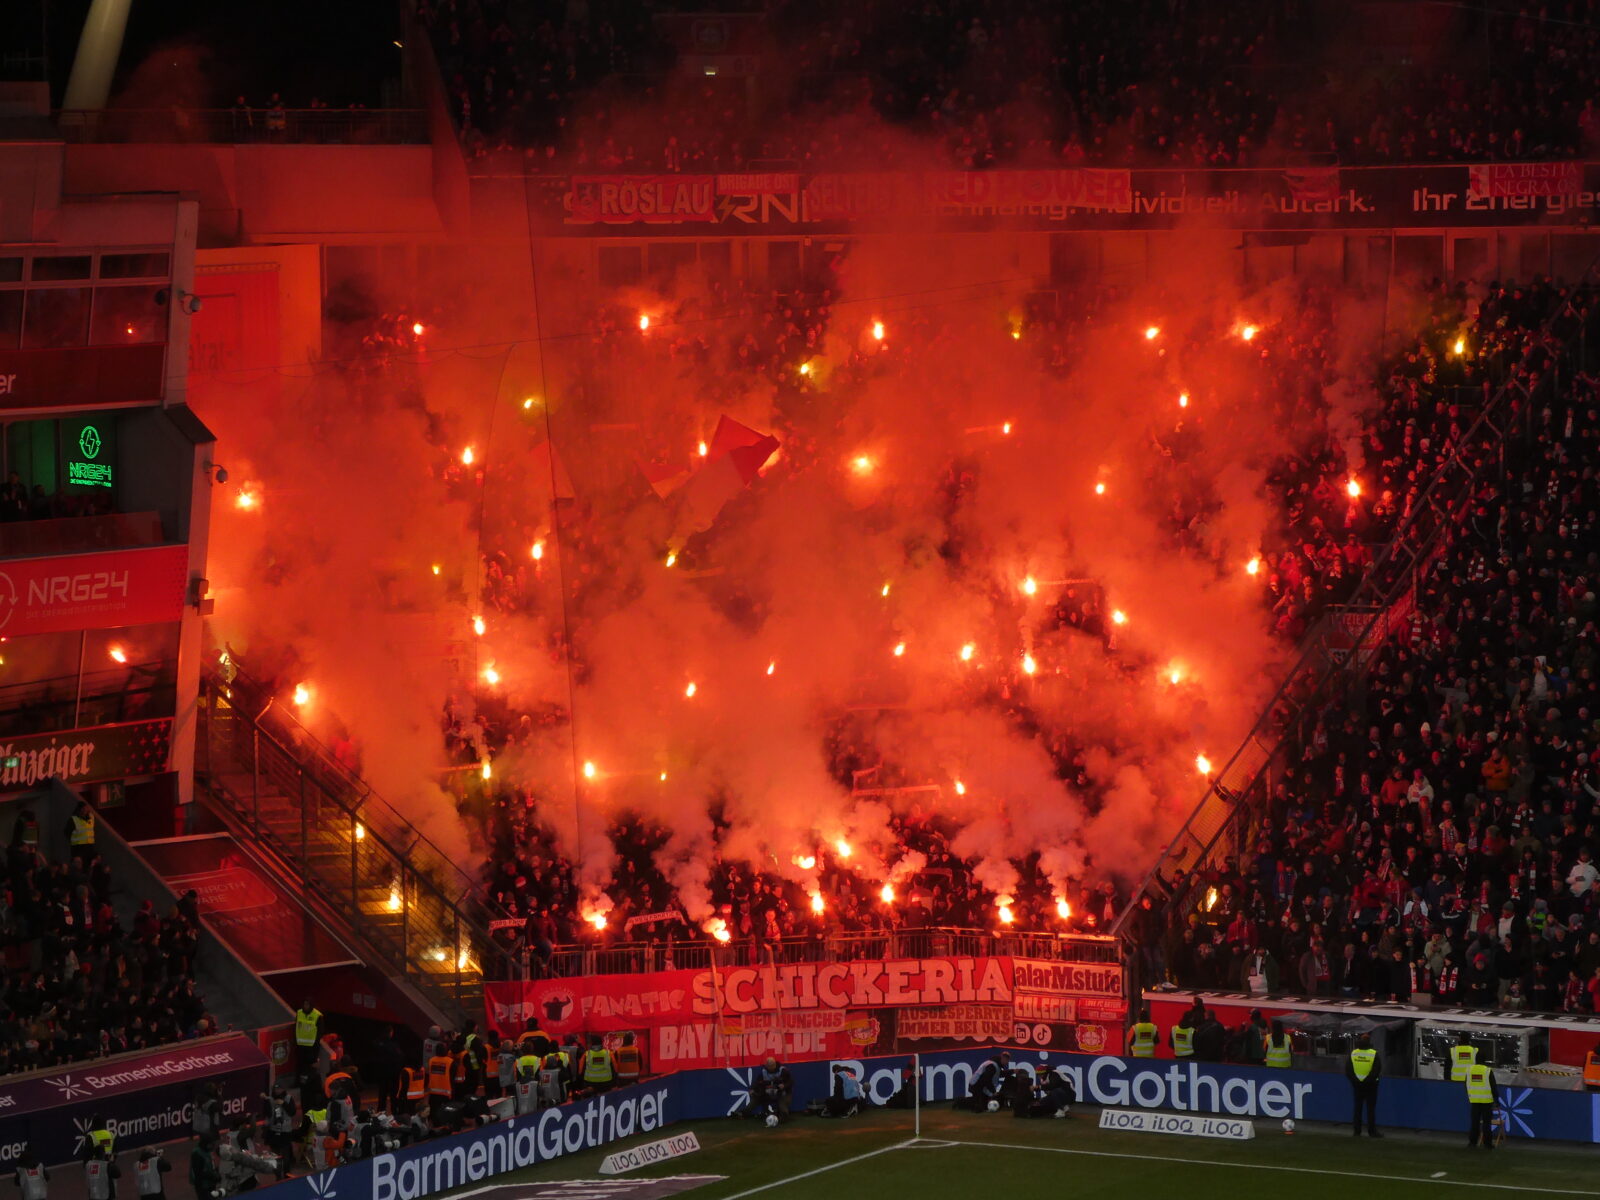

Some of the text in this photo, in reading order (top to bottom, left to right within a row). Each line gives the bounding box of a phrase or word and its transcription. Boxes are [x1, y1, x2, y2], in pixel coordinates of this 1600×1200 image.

[601, 180, 711, 215] RÖSLAU
[1412, 187, 1458, 212] Ihr
[69, 462, 112, 482] NRG24
[28, 570, 129, 606] NRG24
[692, 958, 1012, 1015] SCHICKERIA
[1015, 964, 1121, 993] alarMstufe
[494, 1002, 536, 1024] RED
[580, 989, 685, 1018] FANATIC
[744, 1014, 771, 1029] RED
[898, 1020, 1010, 1036] IMMER BEI UNS
[85, 1052, 233, 1090] BarmeniaGothaer
[106, 1096, 248, 1138] BarmeniaGaer
[1104, 1111, 1244, 1138] iLOQ iLOQ iLOQ
[372, 1087, 668, 1200] BarmeniaGothaer
